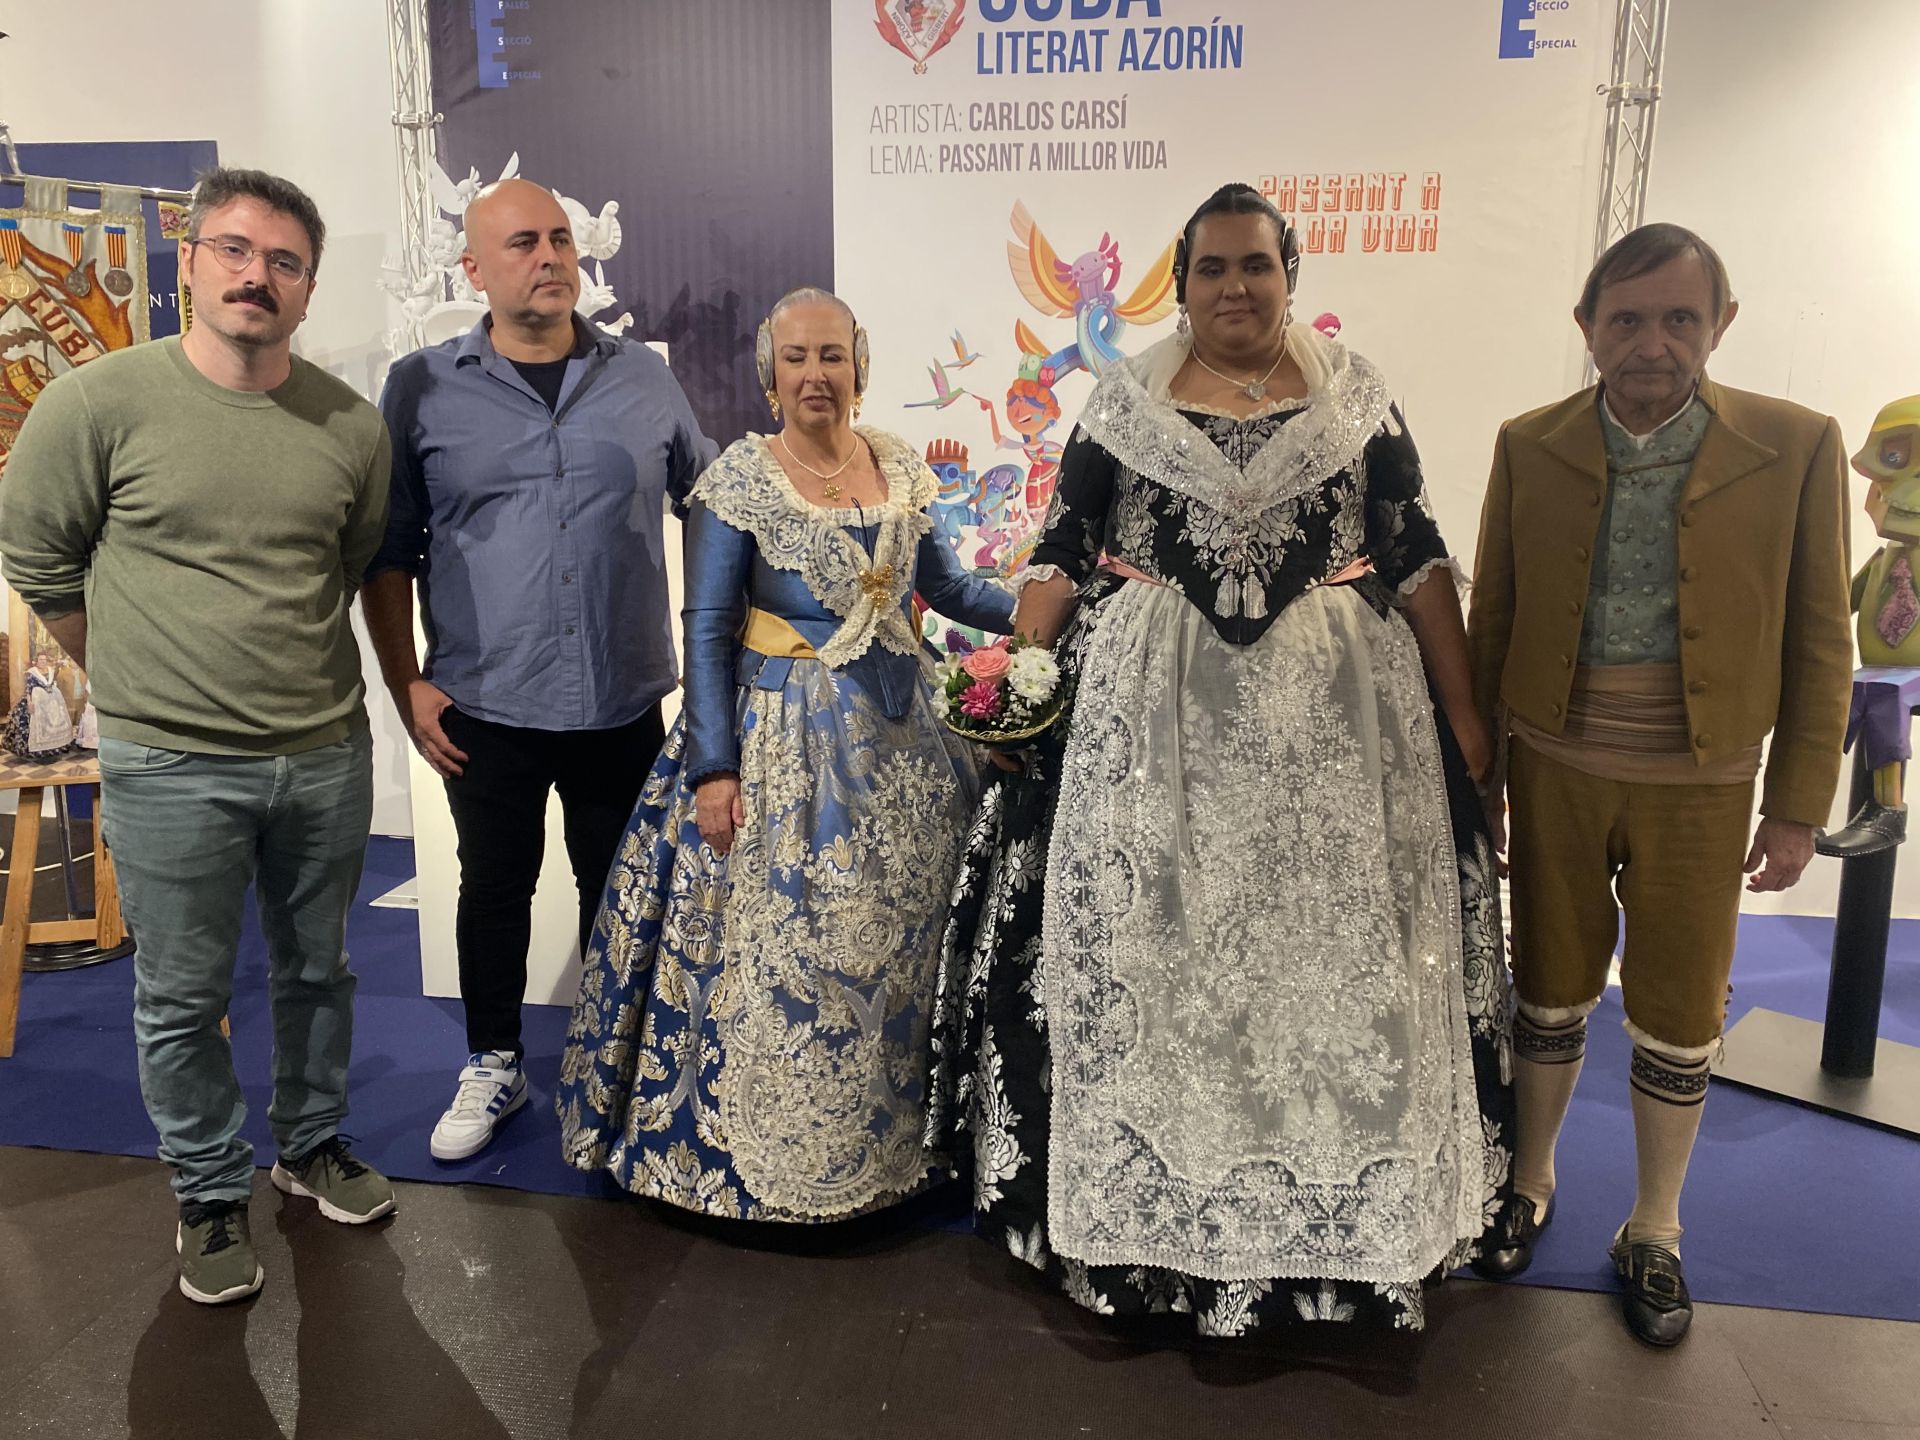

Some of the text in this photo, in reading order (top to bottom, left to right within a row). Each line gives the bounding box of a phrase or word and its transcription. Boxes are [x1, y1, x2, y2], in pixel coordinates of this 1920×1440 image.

[977, 16, 1244, 75] LITERAT AZORÍN
[1528, 39, 1577, 49] ESPECIAL
[869, 94, 1128, 134] ARTISTA: CARLOS CARSÍ
[870, 140, 1168, 174] LEMA: PASSANT A MILLOR VIDA
[1258, 172, 1441, 212] PASSANT A
[1361, 213, 1438, 252] VIDA
